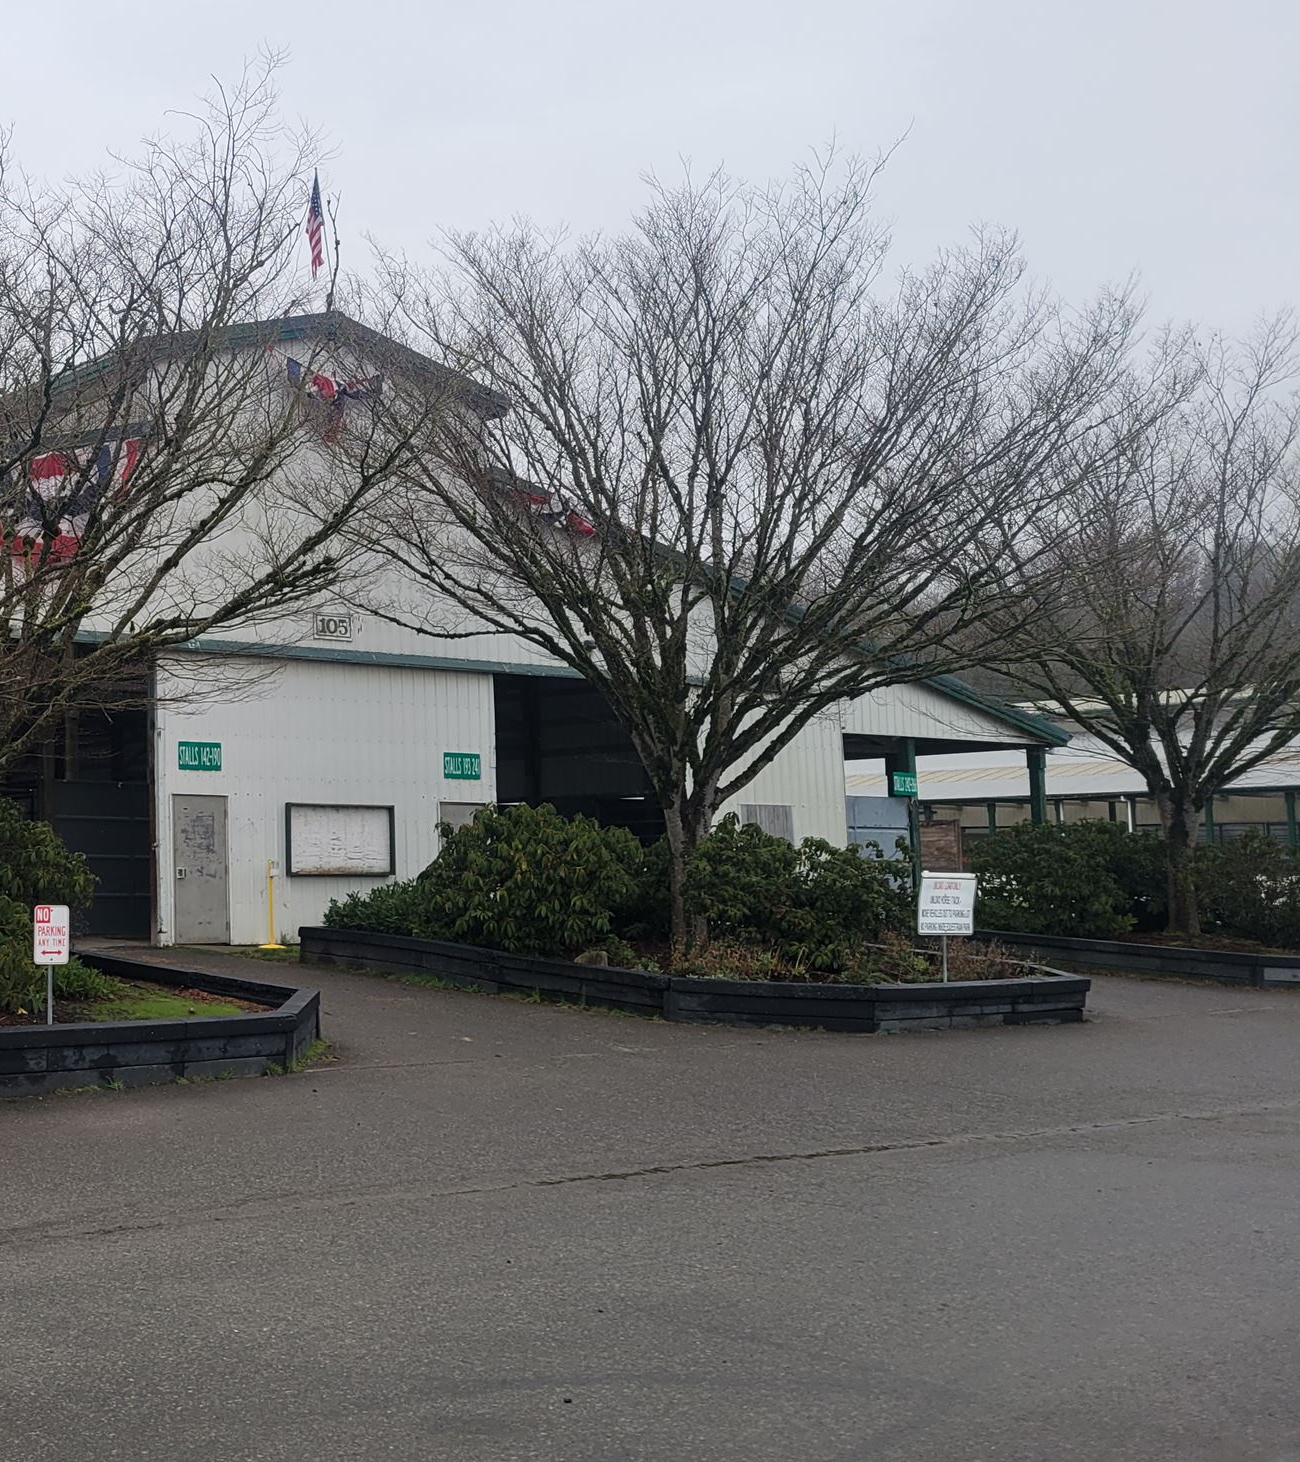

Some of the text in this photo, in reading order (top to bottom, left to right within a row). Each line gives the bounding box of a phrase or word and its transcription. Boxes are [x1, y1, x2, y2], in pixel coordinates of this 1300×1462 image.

[319, 617, 348, 635] 105
[179, 746, 198, 765] STALLS
[445, 757, 461, 775] STALLS
[37, 908, 49, 922] NO
[38, 926, 66, 937] PARKING
[38, 939, 66, 947] ANY TIME
